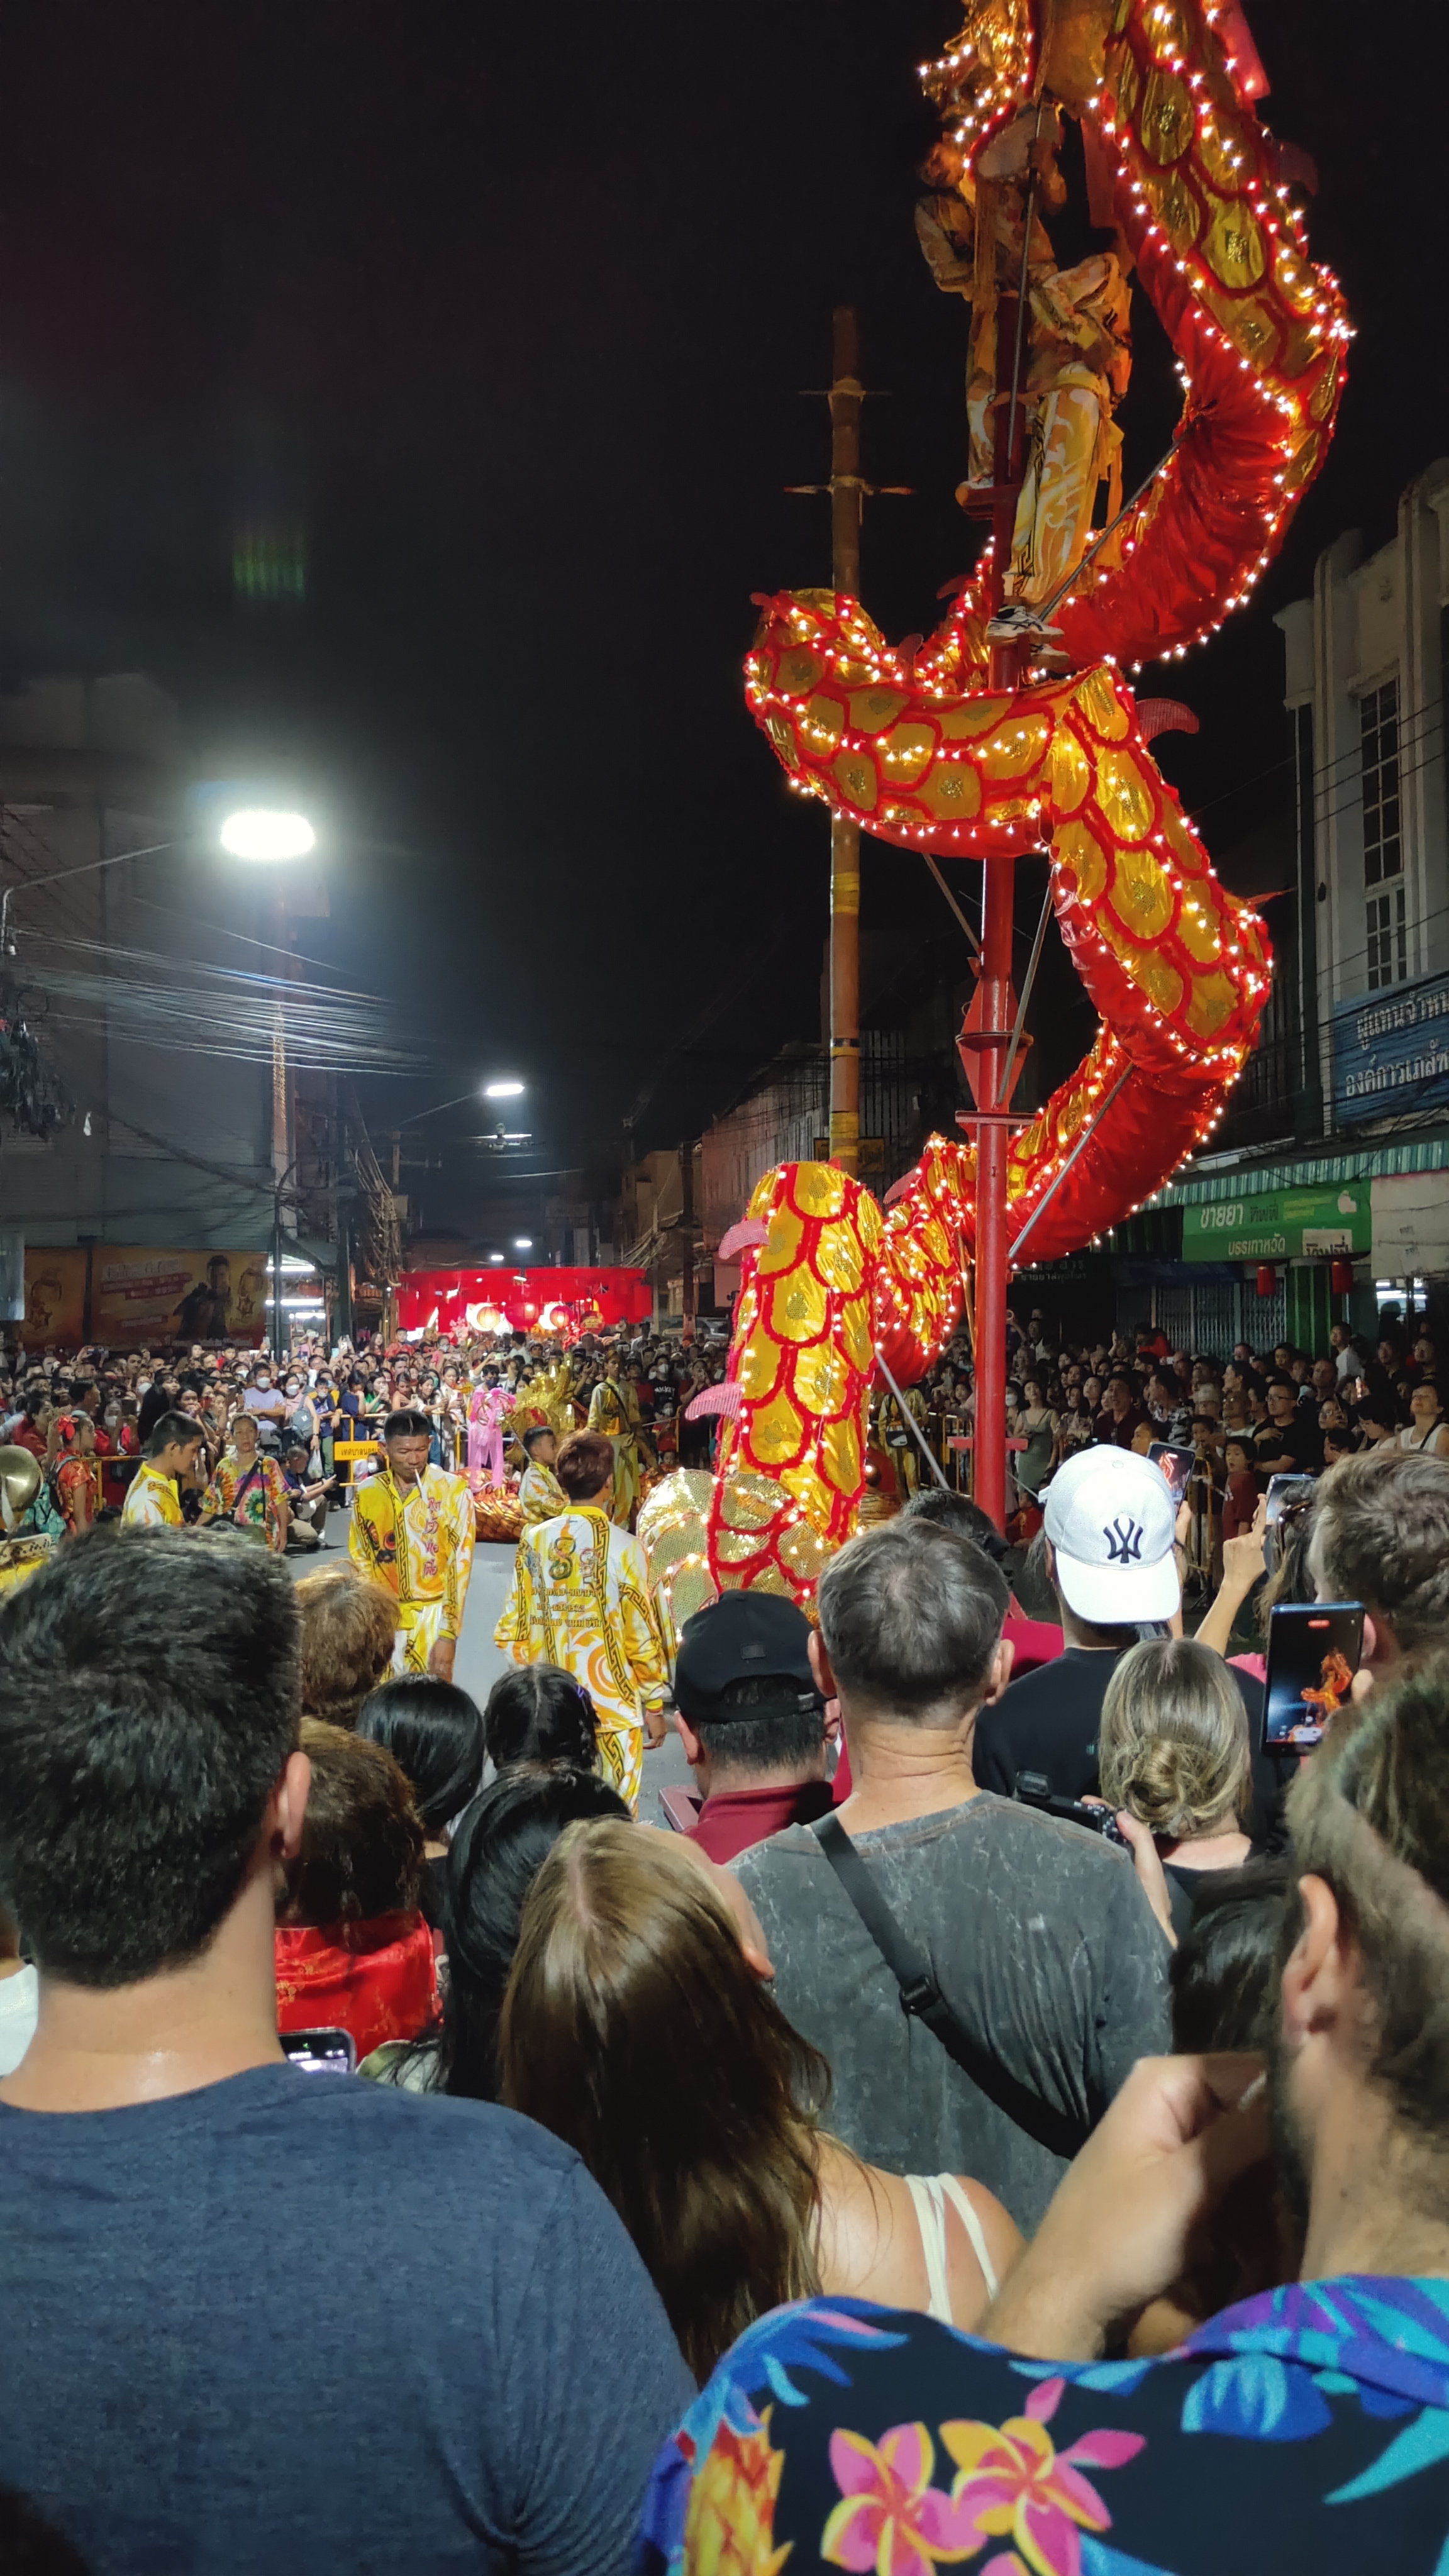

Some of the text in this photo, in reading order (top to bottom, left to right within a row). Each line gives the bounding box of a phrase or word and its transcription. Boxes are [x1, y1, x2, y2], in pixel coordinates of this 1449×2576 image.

[1200, 1203, 1243, 1228] ขายยา
[1228, 1232, 1285, 1256] บรรเทาหวัด
